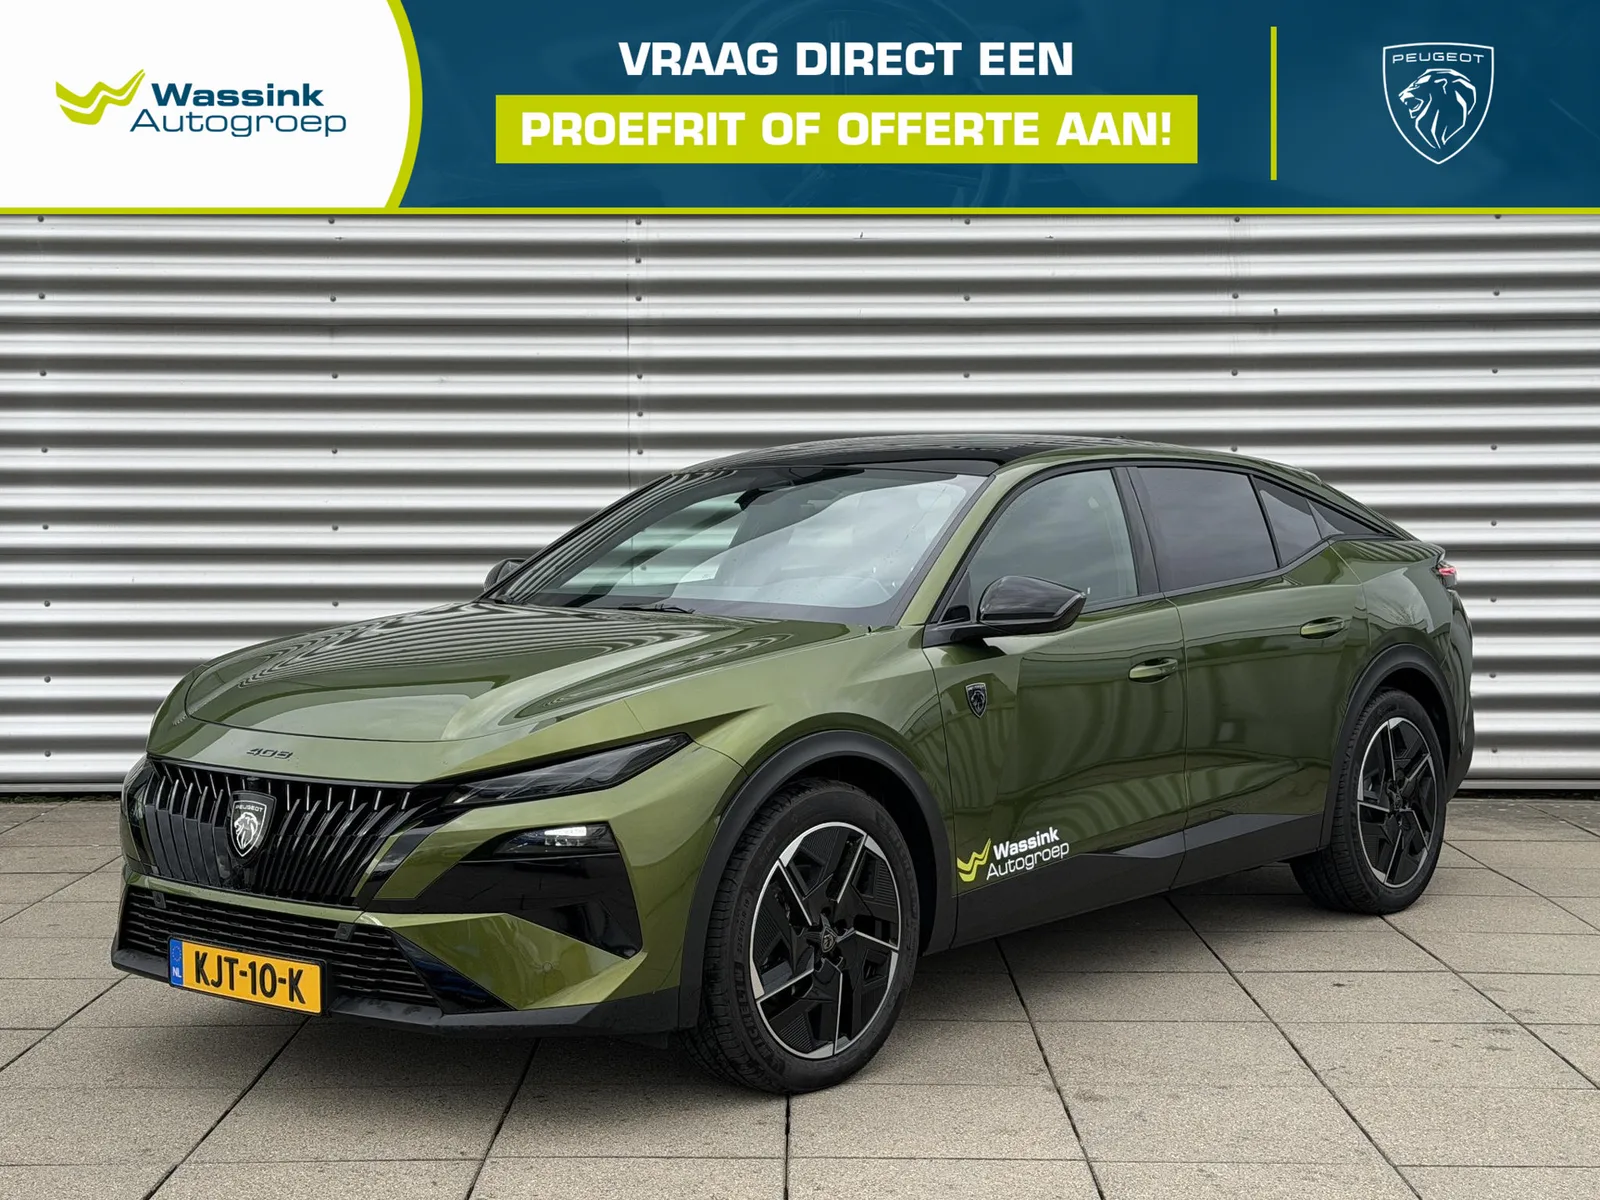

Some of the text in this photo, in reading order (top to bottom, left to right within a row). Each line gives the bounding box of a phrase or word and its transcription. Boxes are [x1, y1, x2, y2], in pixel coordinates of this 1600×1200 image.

[235, 804, 264, 813] PEUGEOT
[993, 826, 1060, 860] Wassink
[986, 842, 1070, 880] Autogroep
[172, 966, 182, 978] NL
[194, 950, 306, 1005] KJT-10-K
